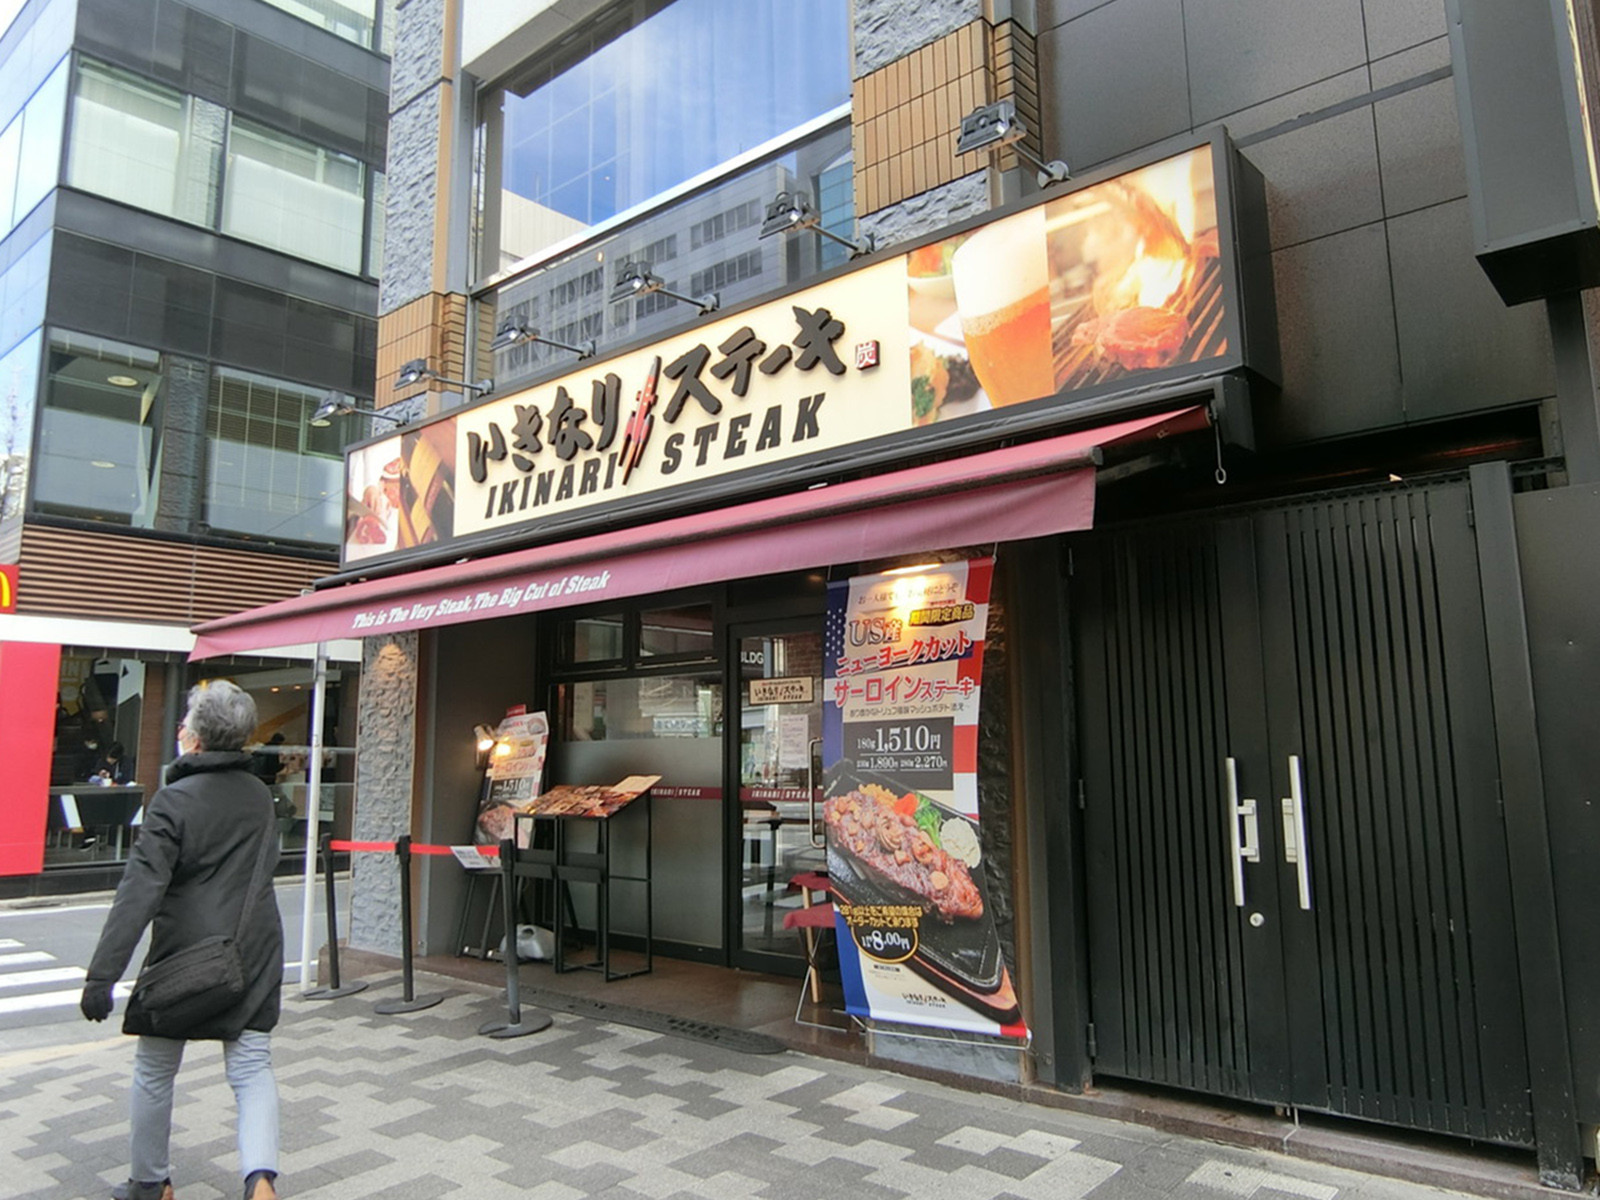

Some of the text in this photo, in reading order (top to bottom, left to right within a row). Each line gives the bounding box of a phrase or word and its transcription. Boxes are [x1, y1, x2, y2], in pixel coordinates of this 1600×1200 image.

[855, 339, 880, 372] 炭
[467, 306, 846, 483] いきなり ステーキ
[485, 393, 827, 519] IKINARI STEAK
[352, 613, 376, 629] This
[376, 612, 387, 626] is
[388, 607, 408, 624] The
[409, 602, 436, 621] Very
[473, 592, 500, 610] The
[502, 586, 524, 608] Big
[524, 580, 548, 601] Cut
[549, 577, 566, 597] of
[566, 570, 611, 595] Steak
[836, 630, 972, 677] ニューヨークカット
[835, 676, 974, 707] サーロインステーキ
